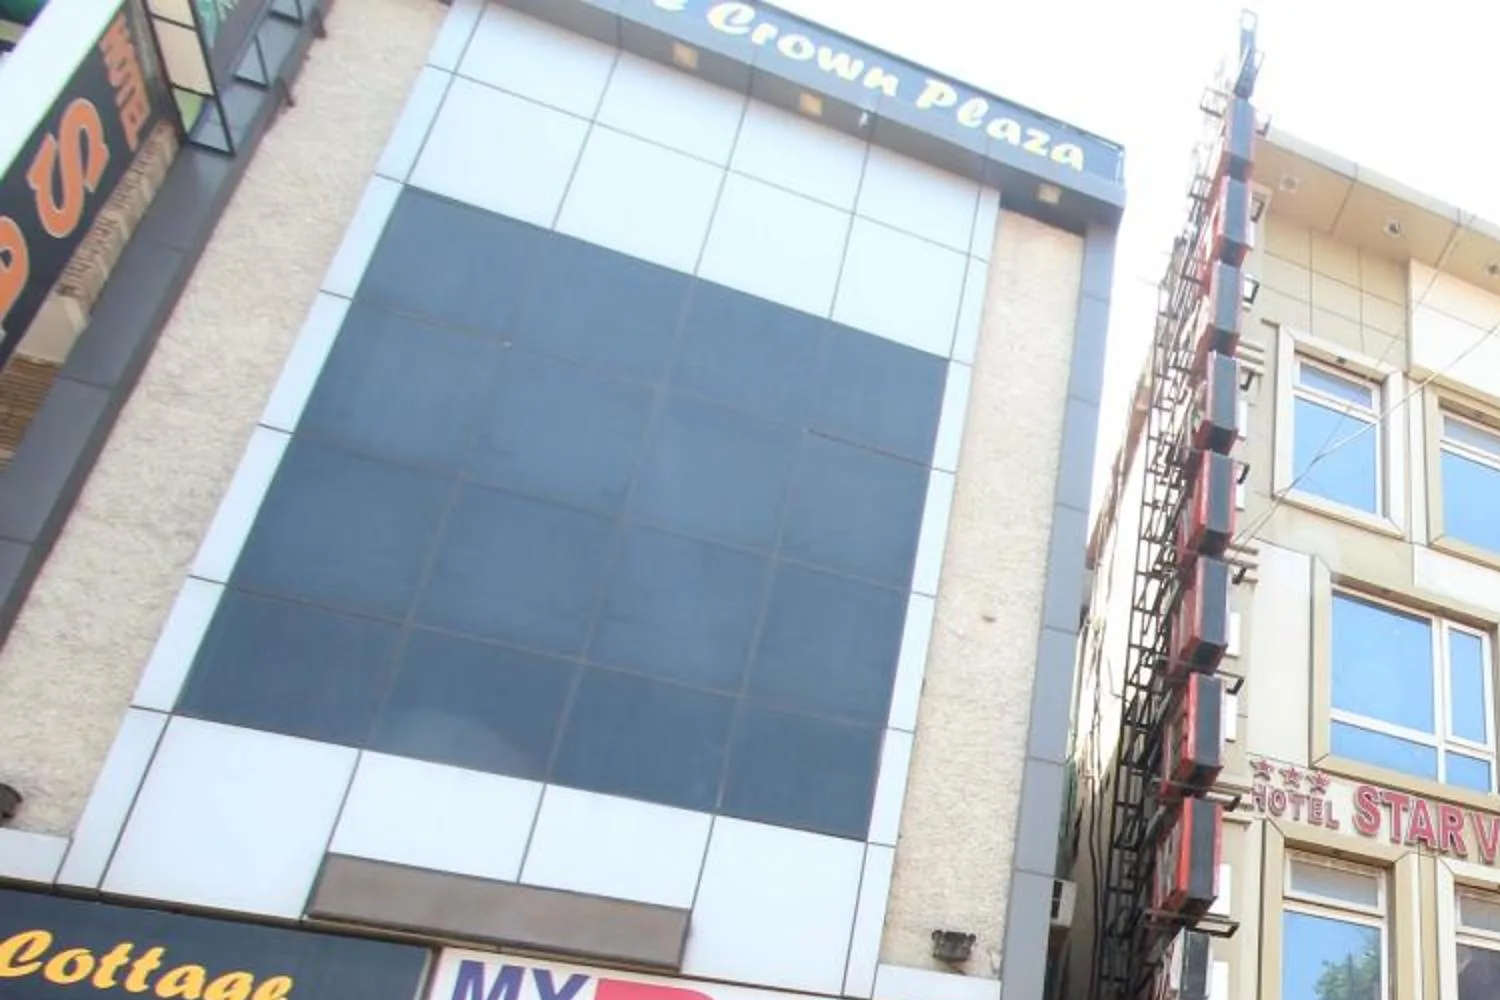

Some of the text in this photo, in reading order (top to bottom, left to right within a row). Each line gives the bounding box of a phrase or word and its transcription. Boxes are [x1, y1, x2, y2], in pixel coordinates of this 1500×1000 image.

[706, 0, 1085, 172] Crown Plaza
[1251, 784, 1340, 829] HOTEL
[1352, 784, 1467, 857] STAR
